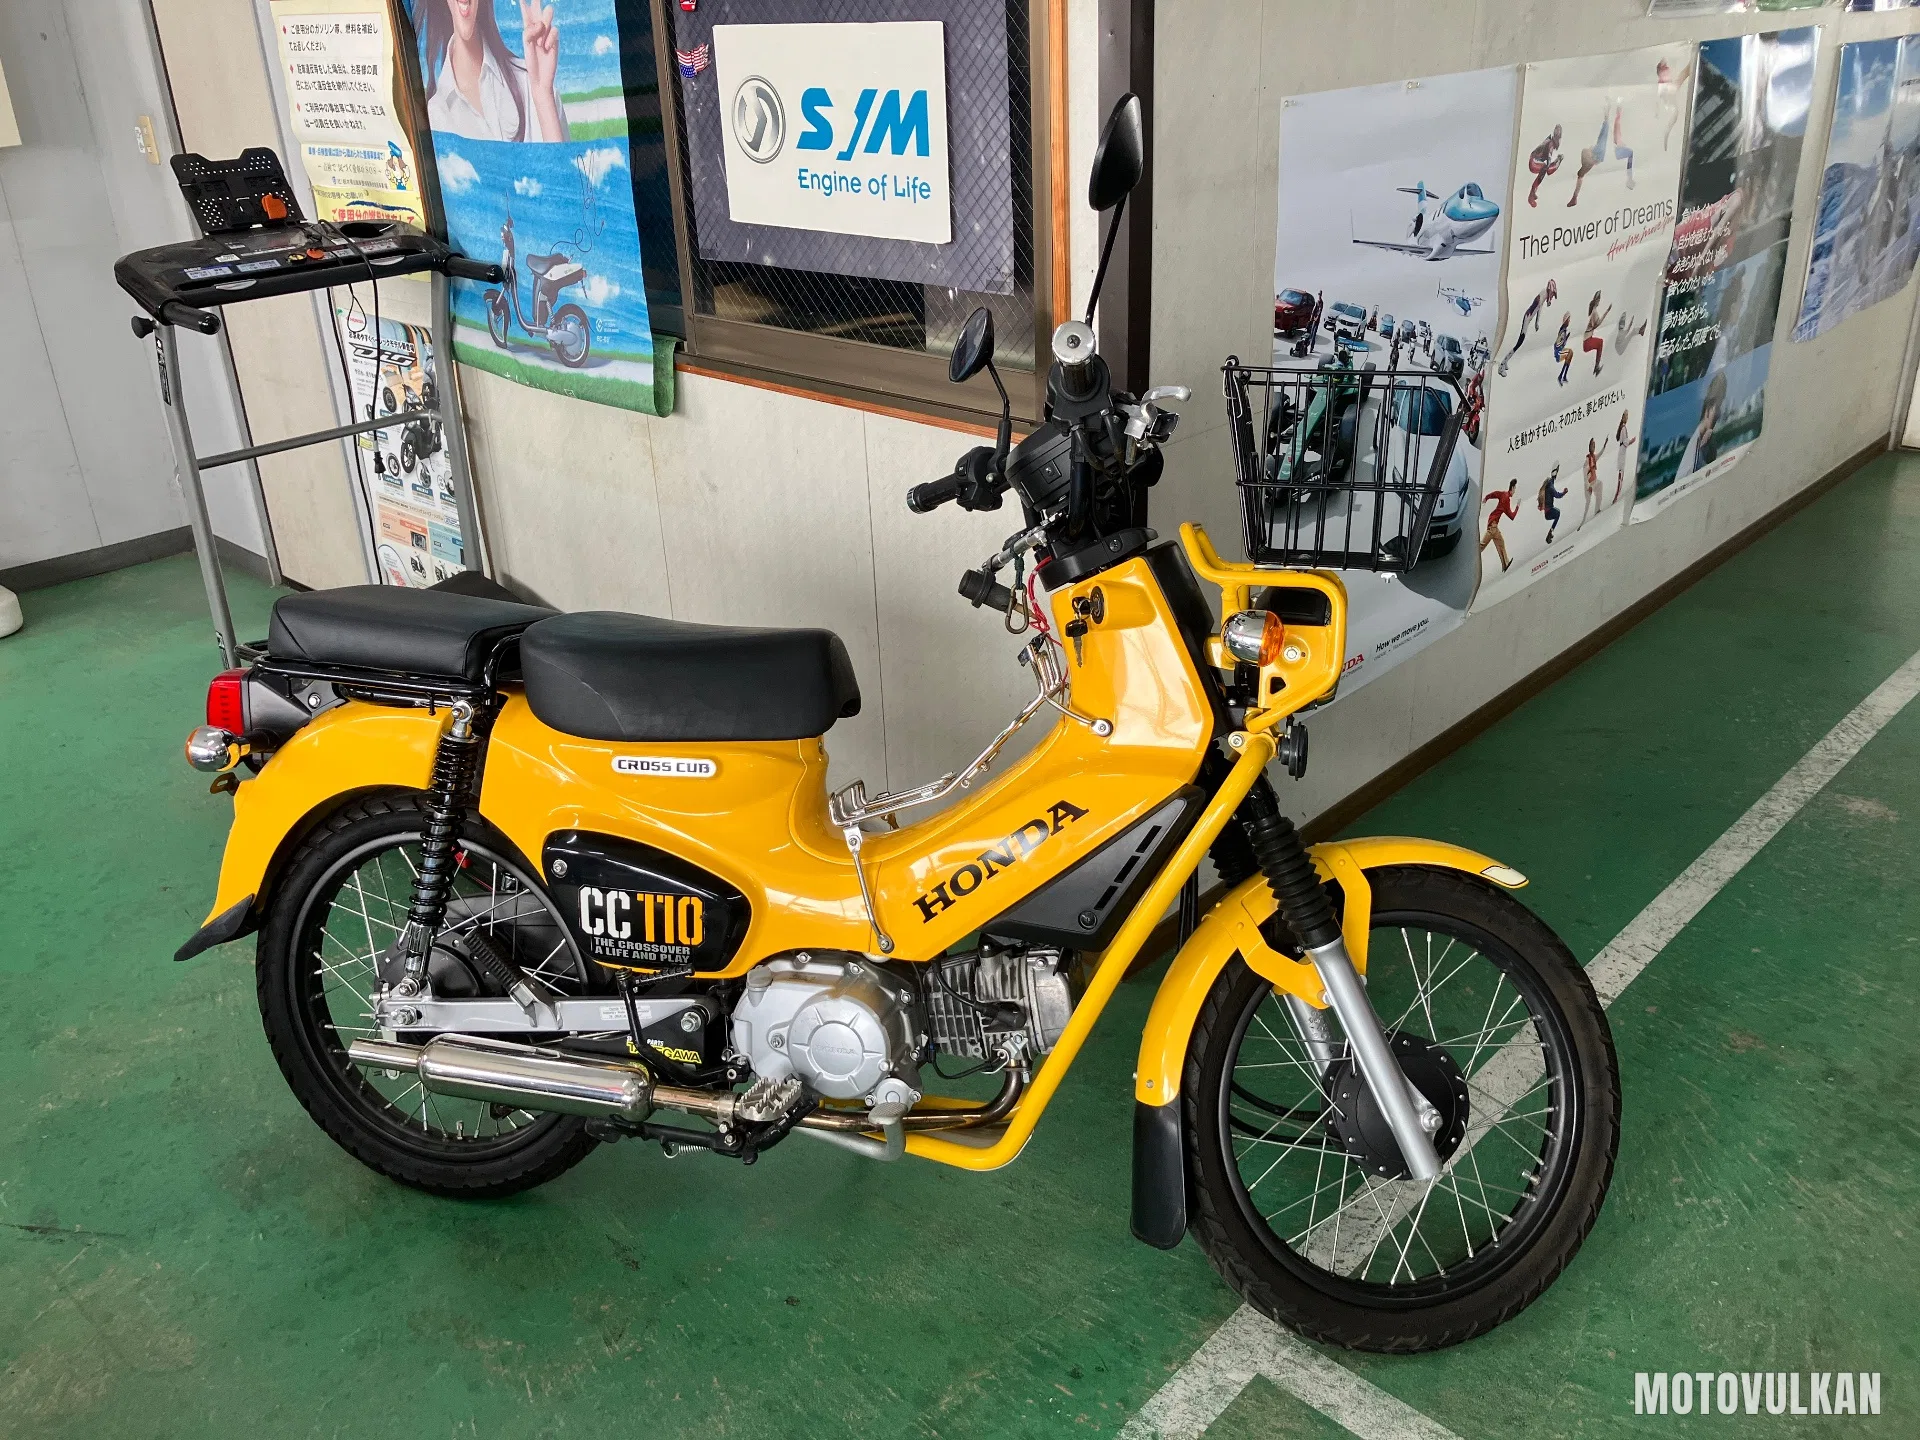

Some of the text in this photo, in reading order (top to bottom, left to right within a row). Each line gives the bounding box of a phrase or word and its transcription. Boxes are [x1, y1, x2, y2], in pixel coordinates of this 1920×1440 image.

[798, 168, 932, 203] Engine of Life
[1519, 199, 1673, 260] The Power of Dreams
[1375, 640, 1391, 653] How
[1391, 633, 1401, 644] we
[1400, 624, 1417, 639] move
[618, 759, 710, 774] CROSS CUB
[912, 799, 1090, 924] HONDA
[579, 886, 703, 946] CC 110
[595, 937, 691, 955] THE CROSSOVER
[595, 947, 691, 964] A LIFE AND PLAY
[647, 1038, 664, 1047] PARTS
